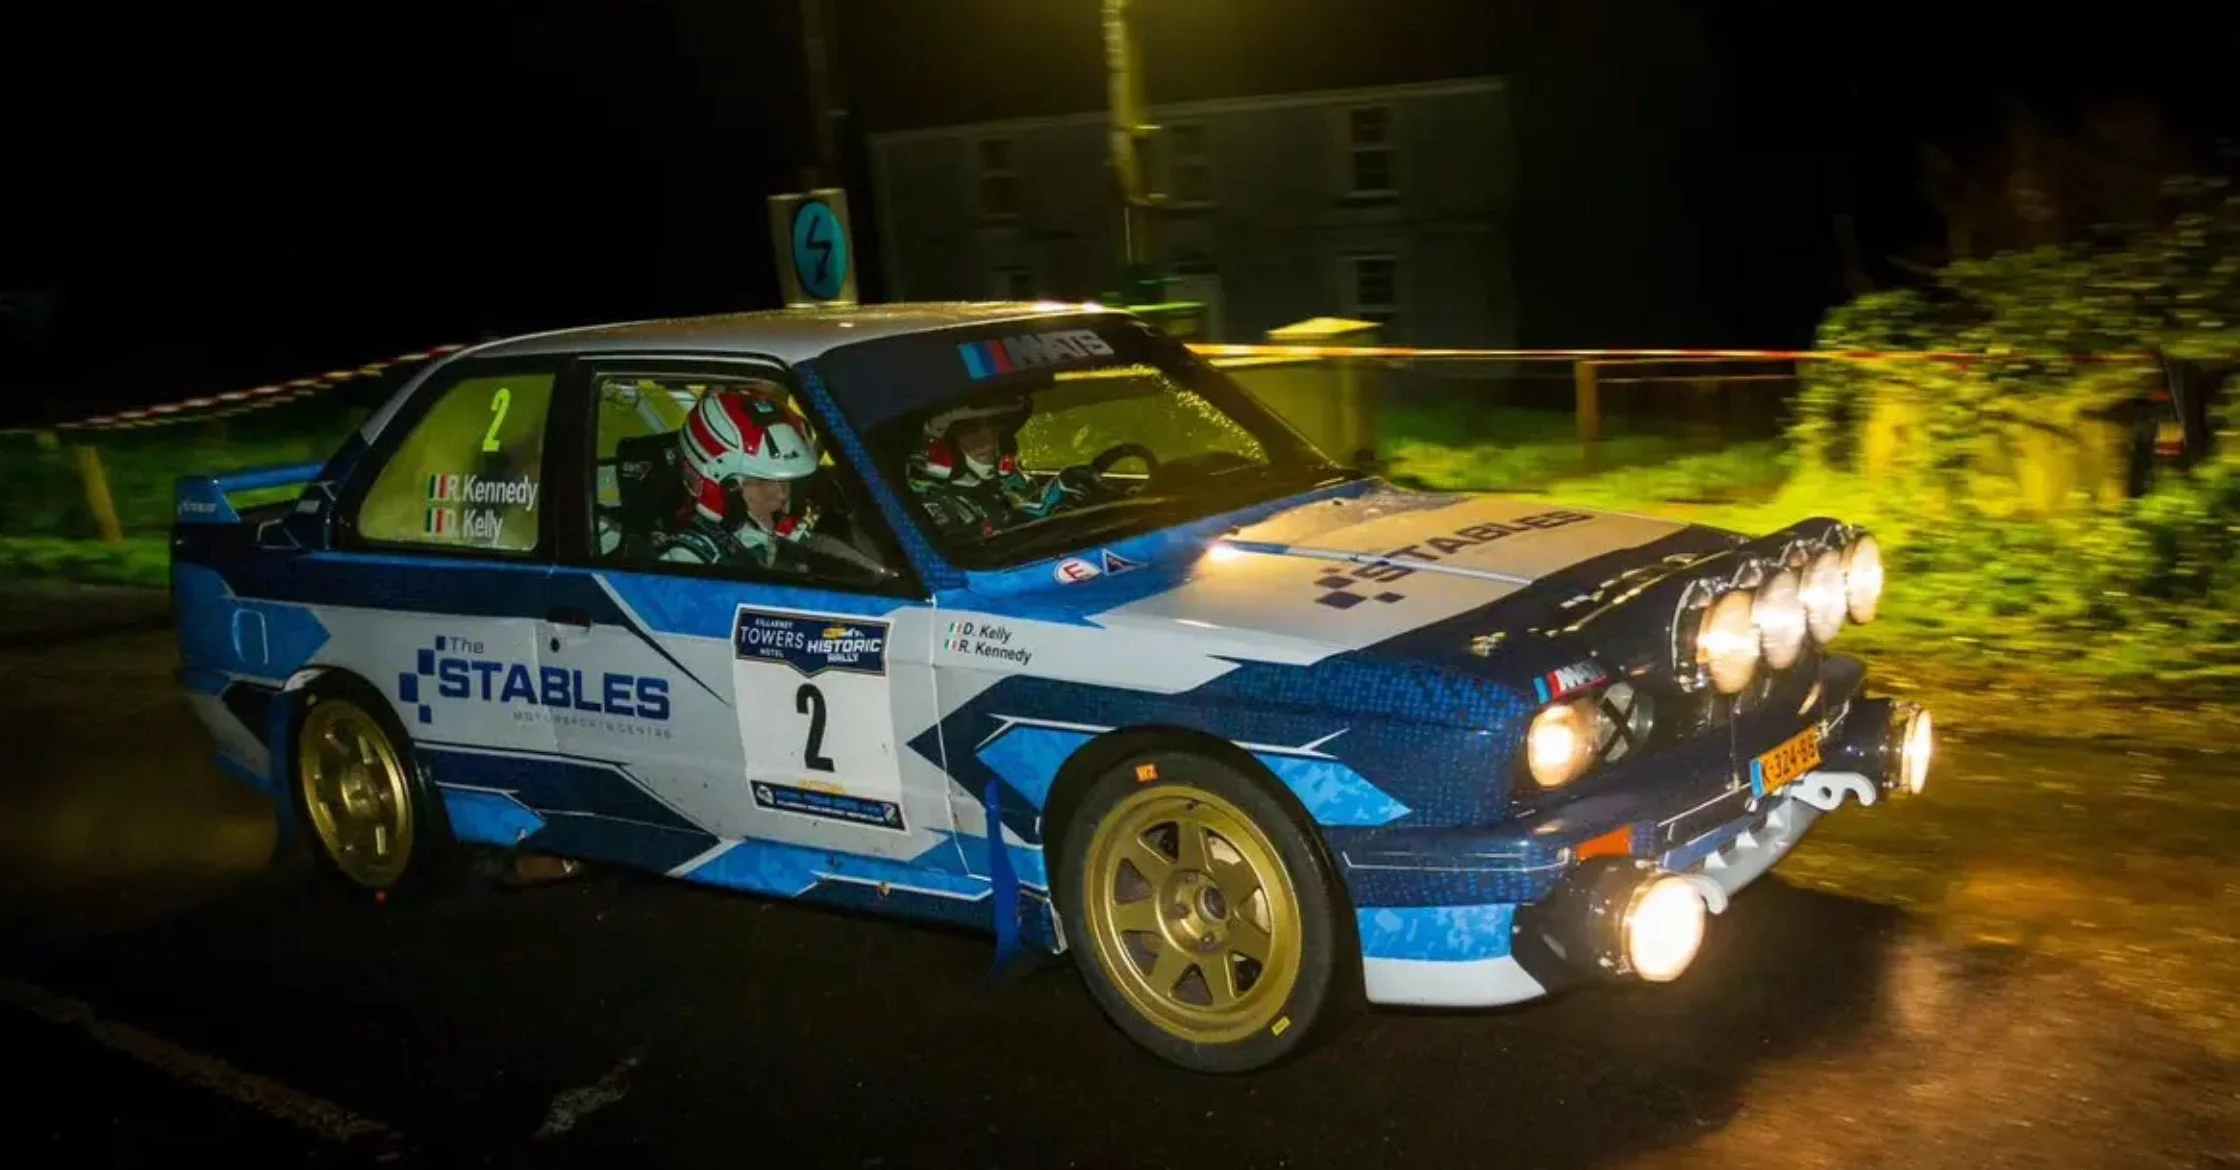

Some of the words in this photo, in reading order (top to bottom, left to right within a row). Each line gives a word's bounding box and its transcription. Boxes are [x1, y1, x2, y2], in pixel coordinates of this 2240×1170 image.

[481, 387, 511, 452] 2
[463, 474, 538, 511] Kennedy
[463, 508, 504, 545] Kelly
[1351, 510, 1594, 584] STABLES
[449, 636, 485, 655] The
[740, 626, 804, 648] TOWERS
[963, 622, 976, 637] D.
[979, 625, 1013, 644] Kelly
[760, 648, 784, 658] HOTEL
[807, 639, 882, 653] HISTORIC
[827, 652, 859, 663] RALLY
[975, 641, 1032, 666] Kennedy
[439, 658, 670, 720] STABLES
[796, 682, 836, 773] 2
